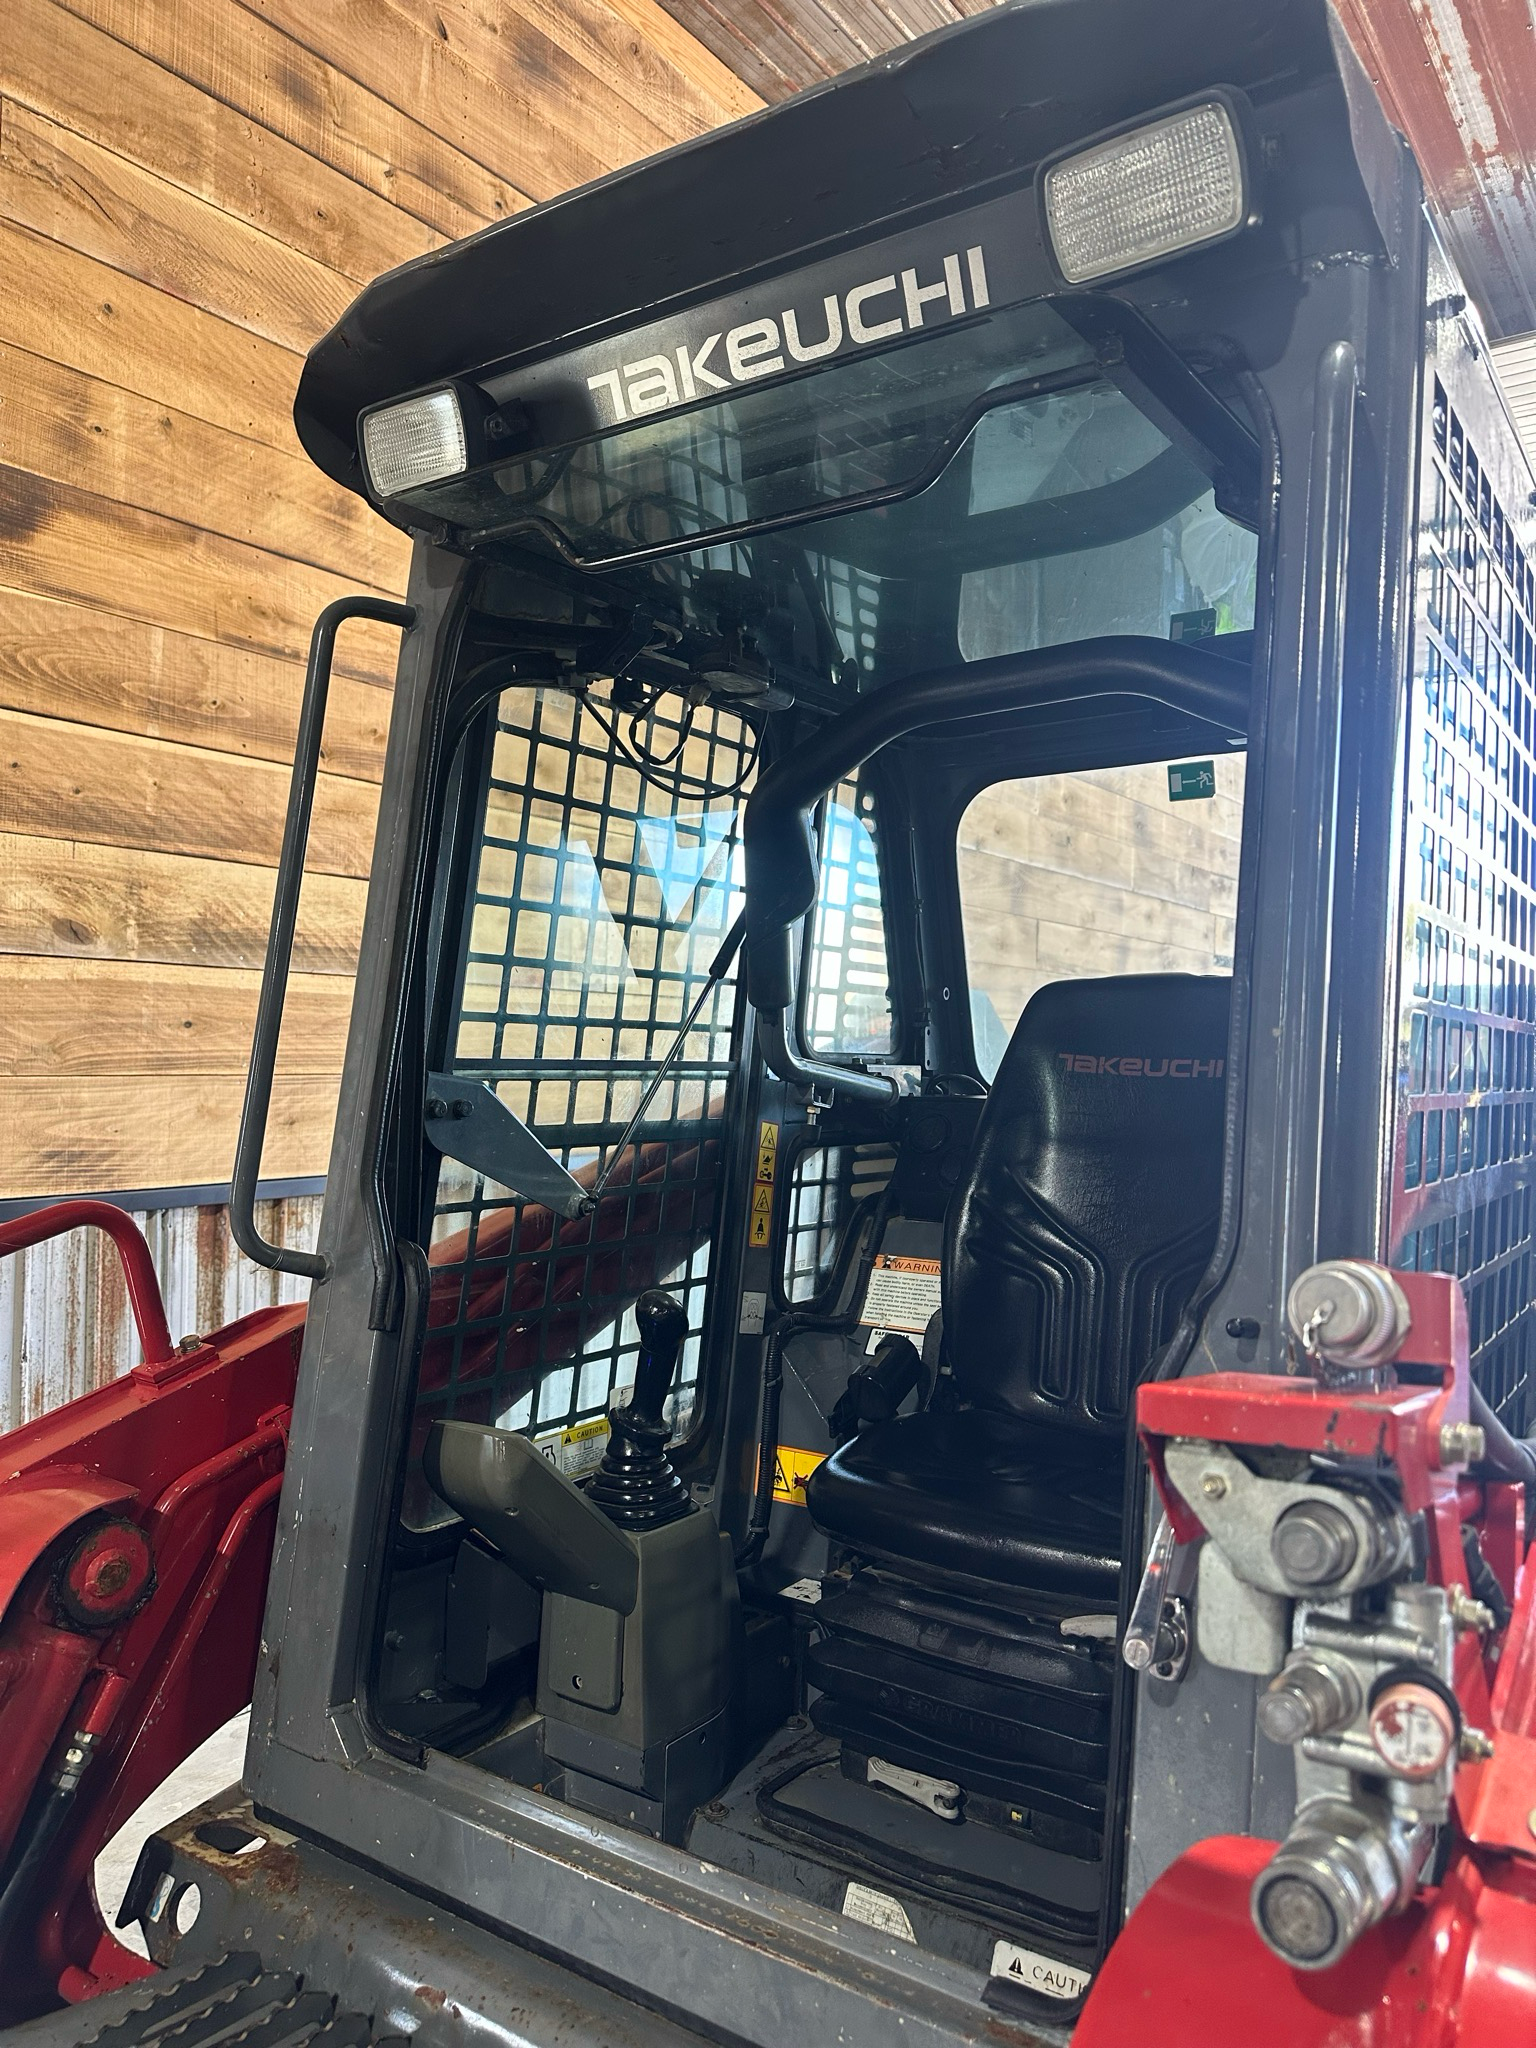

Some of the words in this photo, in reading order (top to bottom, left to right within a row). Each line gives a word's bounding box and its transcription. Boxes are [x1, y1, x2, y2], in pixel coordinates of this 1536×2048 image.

[587, 245, 990, 420] TAKEUCHI
[1059, 1053, 1225, 1078] TAKEUCHI
[894, 1262, 942, 1273] WARNIN
[576, 1425, 604, 1438] CAUTION
[1032, 1965, 1082, 1994] CAUTI
